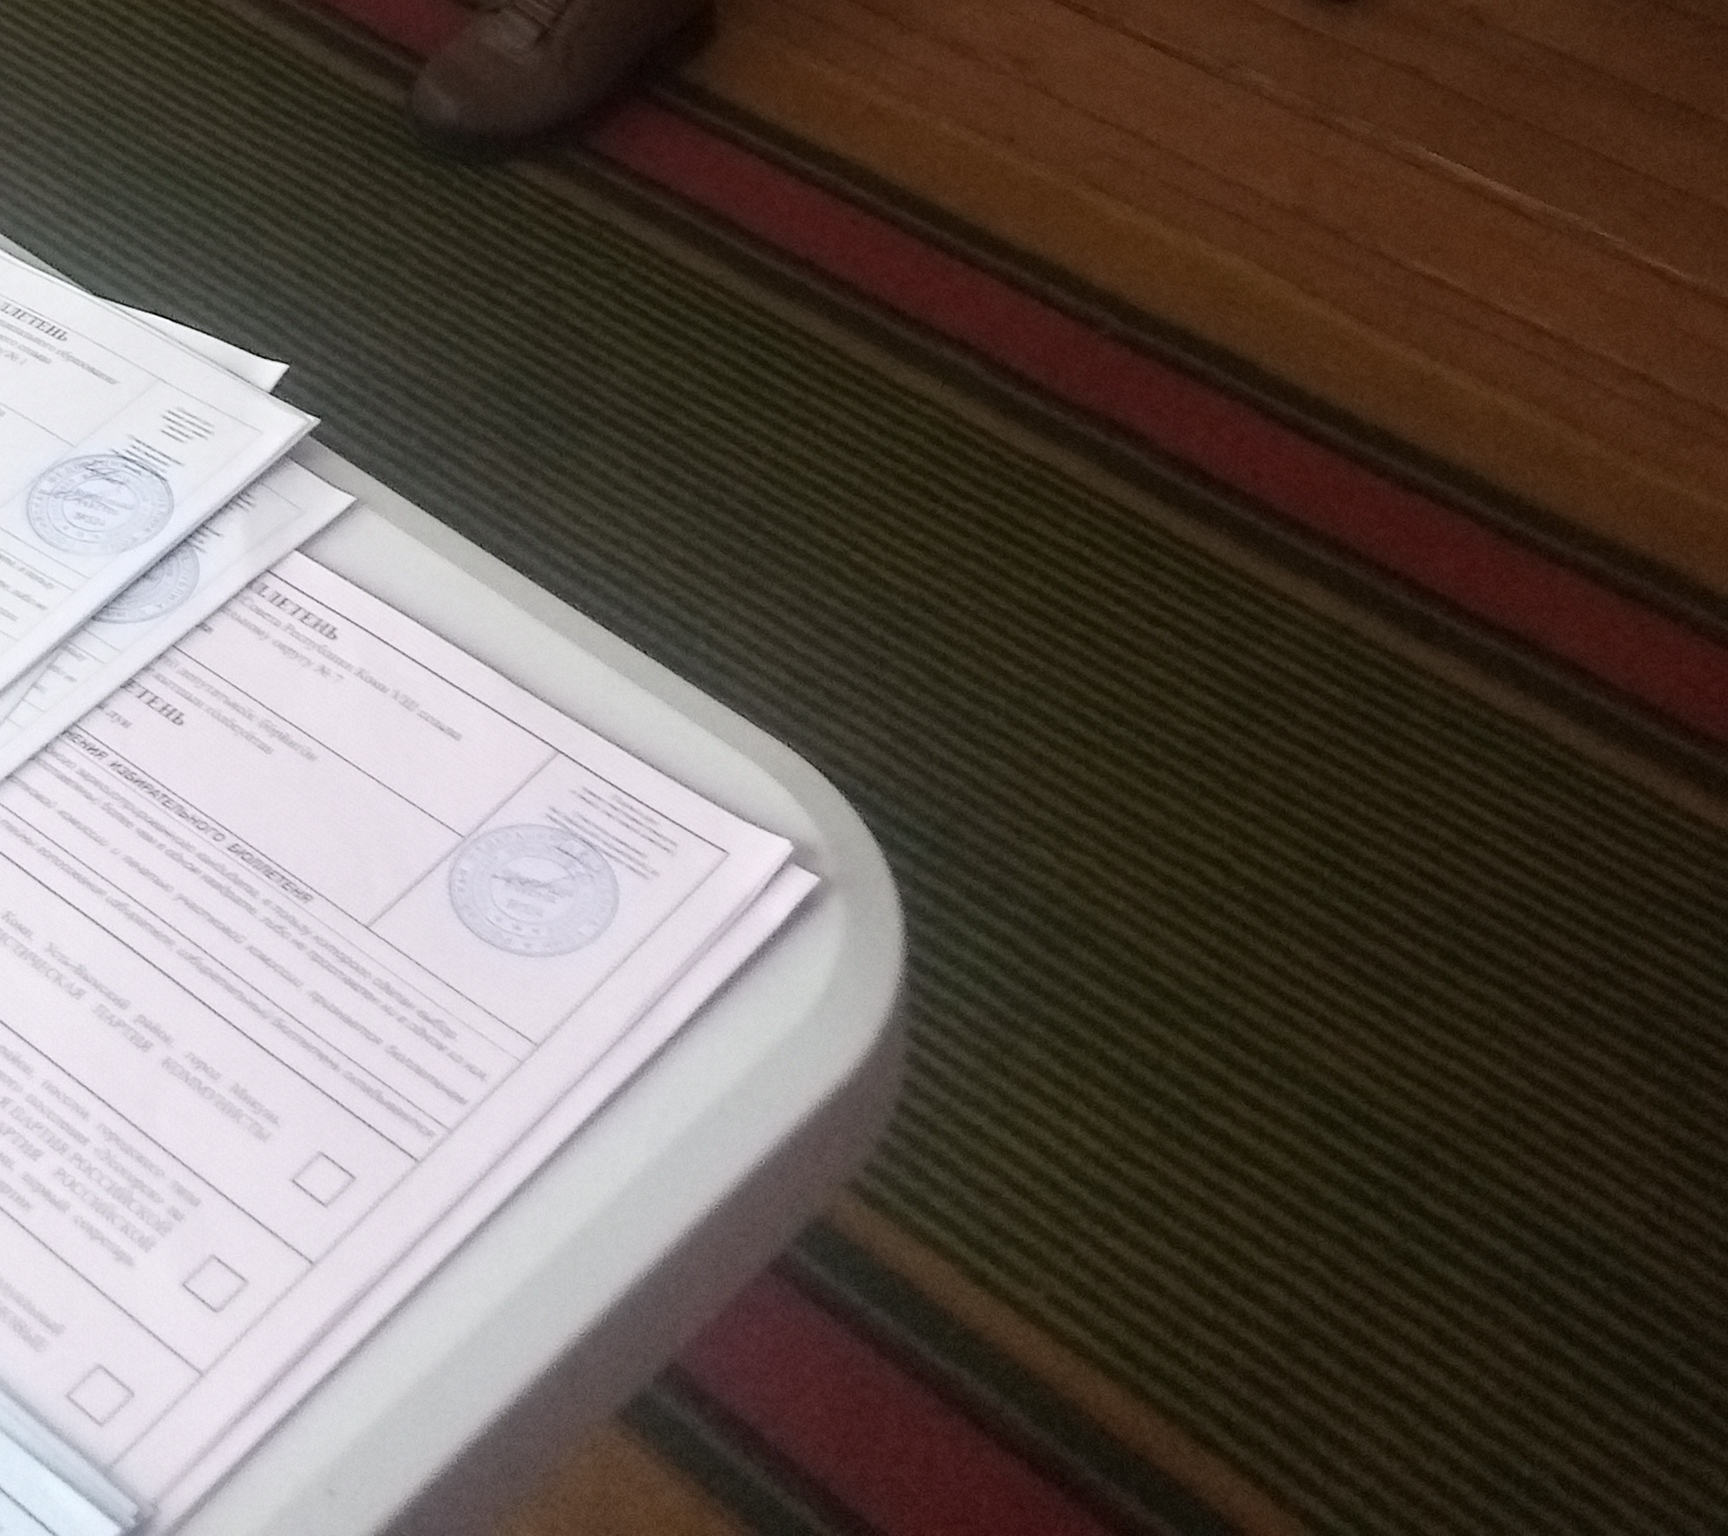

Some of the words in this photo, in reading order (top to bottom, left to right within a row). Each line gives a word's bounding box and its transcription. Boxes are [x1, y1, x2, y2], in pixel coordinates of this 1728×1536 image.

[246, 577, 344, 642] ЛЛЕТЕНЬ
[120, 677, 191, 728] ЕТЕНЬ
[60, 726, 110, 762] НЕНИЯ
[106, 758, 227, 845] ИЗБИРАТЕЛЬНОГО
[225, 840, 315, 905] БЮЛЛЕТЕНЯ
